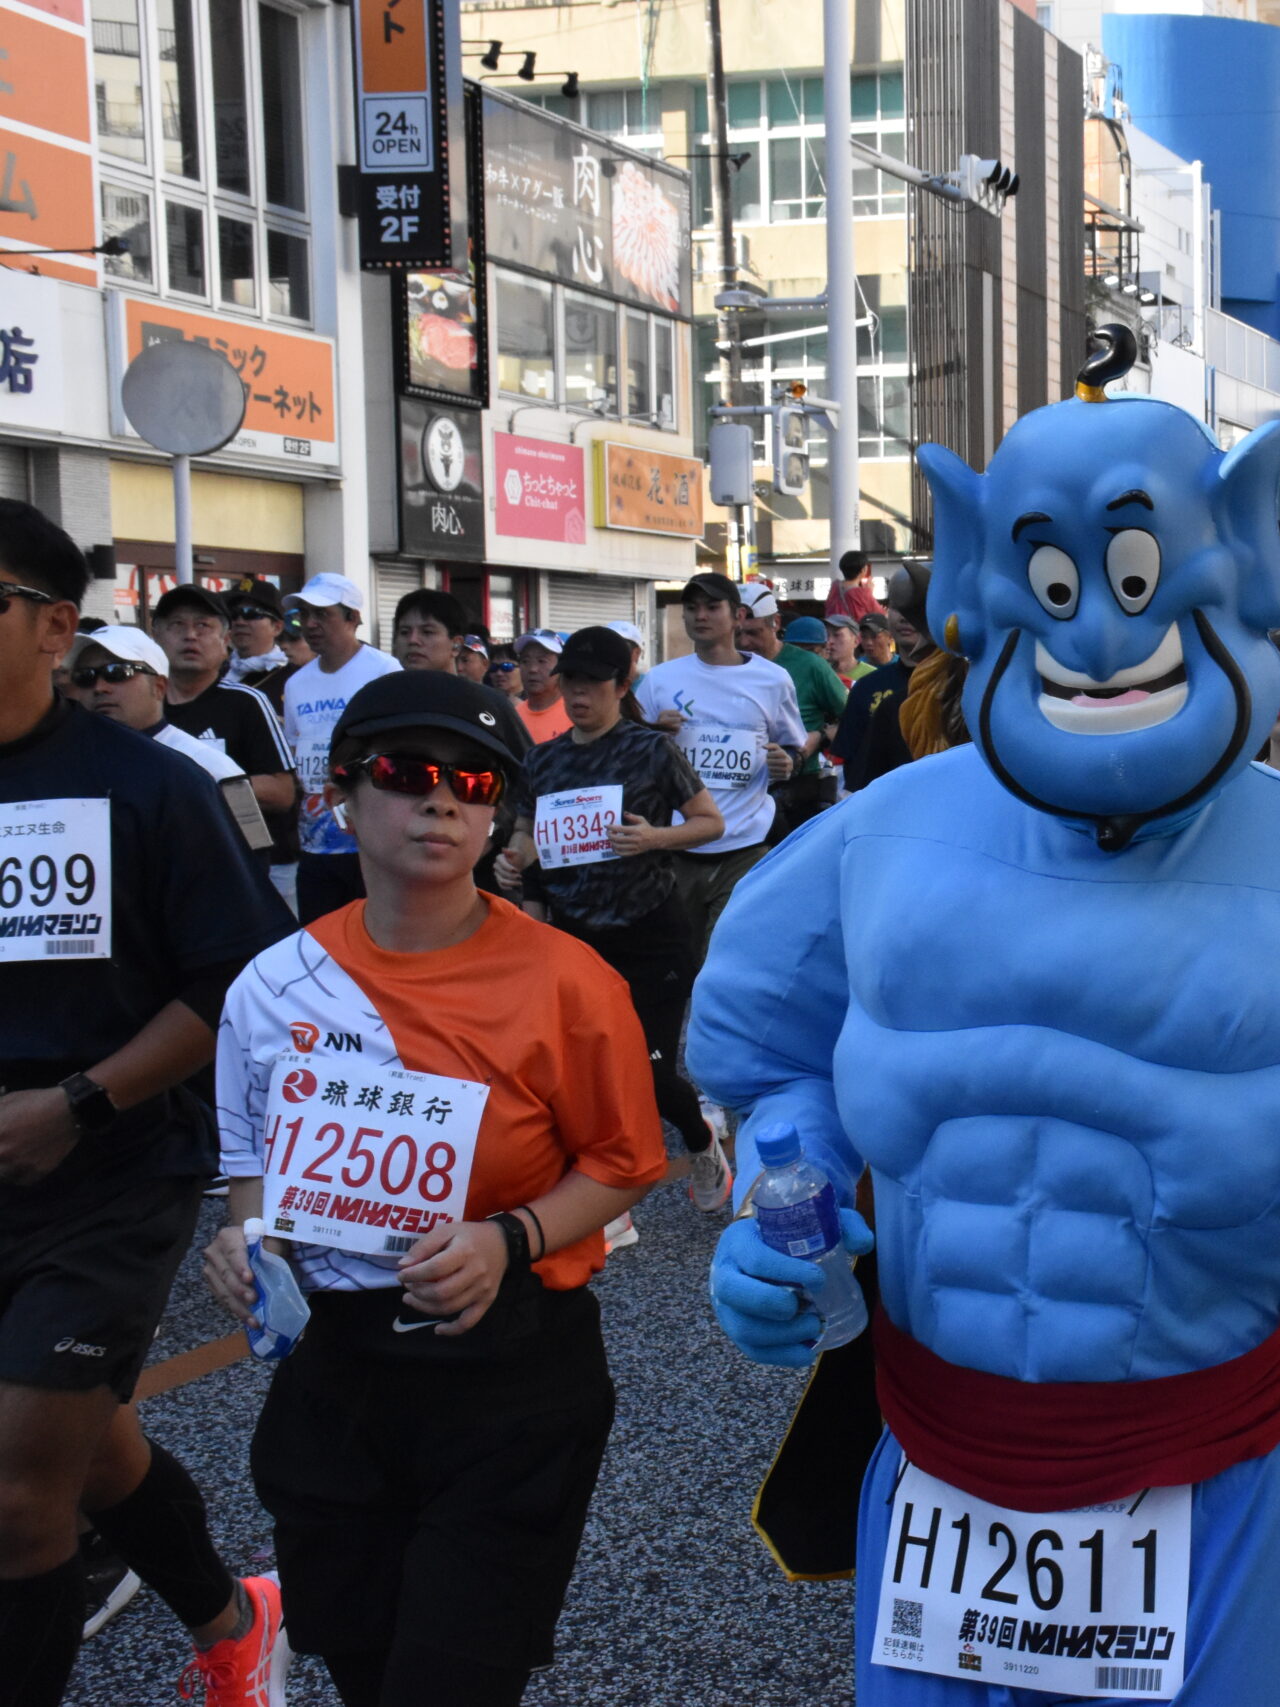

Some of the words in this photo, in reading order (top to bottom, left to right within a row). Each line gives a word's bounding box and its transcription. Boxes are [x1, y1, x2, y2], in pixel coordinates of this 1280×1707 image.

[372, 138, 421, 154] OPEN
[376, 185, 421, 209] 受付
[381, 216, 419, 242] 2F
[572, 144, 604, 283] 肉心
[0, 327, 38, 394] 店
[432, 502, 464, 534] 肉心
[296, 698, 347, 716] TAIWA
[296, 756, 329, 776] H128
[0, 820, 66, 838] ヌエヌ生命
[0, 853, 96, 909] 699
[323, 1032, 363, 1053] NN
[320, 1080, 453, 1126] 琉球銀行
[265, 1114, 457, 1203] H12508
[278, 1185, 332, 1217] 第39回
[892, 1502, 1158, 1614] H12611
[958, 1608, 1019, 1652] 第39回
[1018, 1620, 1176, 1661] NAHAマラソン
[882, 1651, 925, 1663] こちらから
